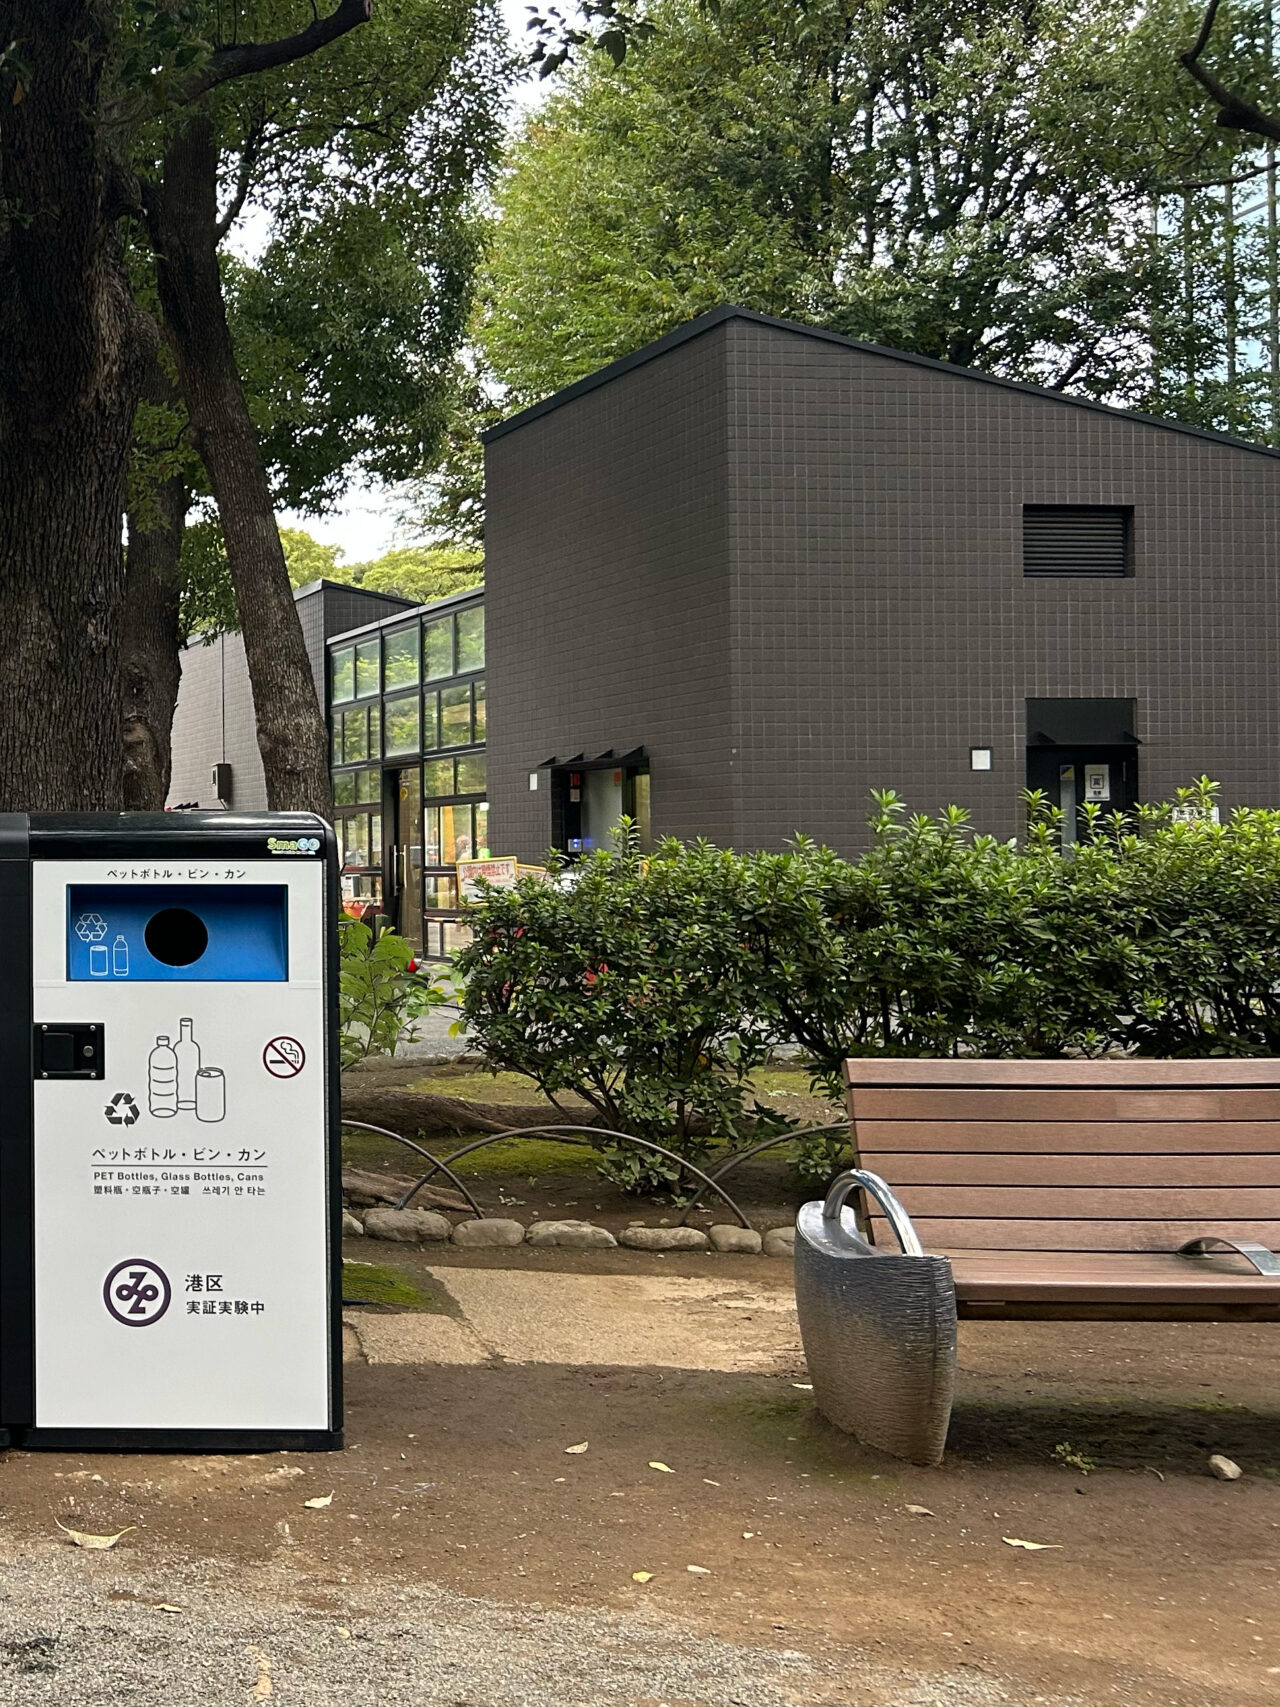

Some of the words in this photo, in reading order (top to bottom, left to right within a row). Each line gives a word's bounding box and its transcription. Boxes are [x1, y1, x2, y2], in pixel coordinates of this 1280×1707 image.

[267, 837, 320, 851] SmaGO
[106, 868, 247, 880] ペットボトル・ビン・カン
[92, 1147, 266, 1162] ペットボトル・ビン・カン
[93, 1171, 115, 1181] PET
[117, 1171, 158, 1183] Bottles,
[160, 1172, 191, 1182] Glass
[193, 1172, 235, 1183] Bottles,
[237, 1172, 264, 1182] Cans
[202, 1186, 230, 1196] 쓰레기
[233, 1186, 244, 1196] 안
[246, 1186, 266, 1196] 타는
[184, 1273, 224, 1293] 港区
[186, 1299, 265, 1316] 実証実験中
